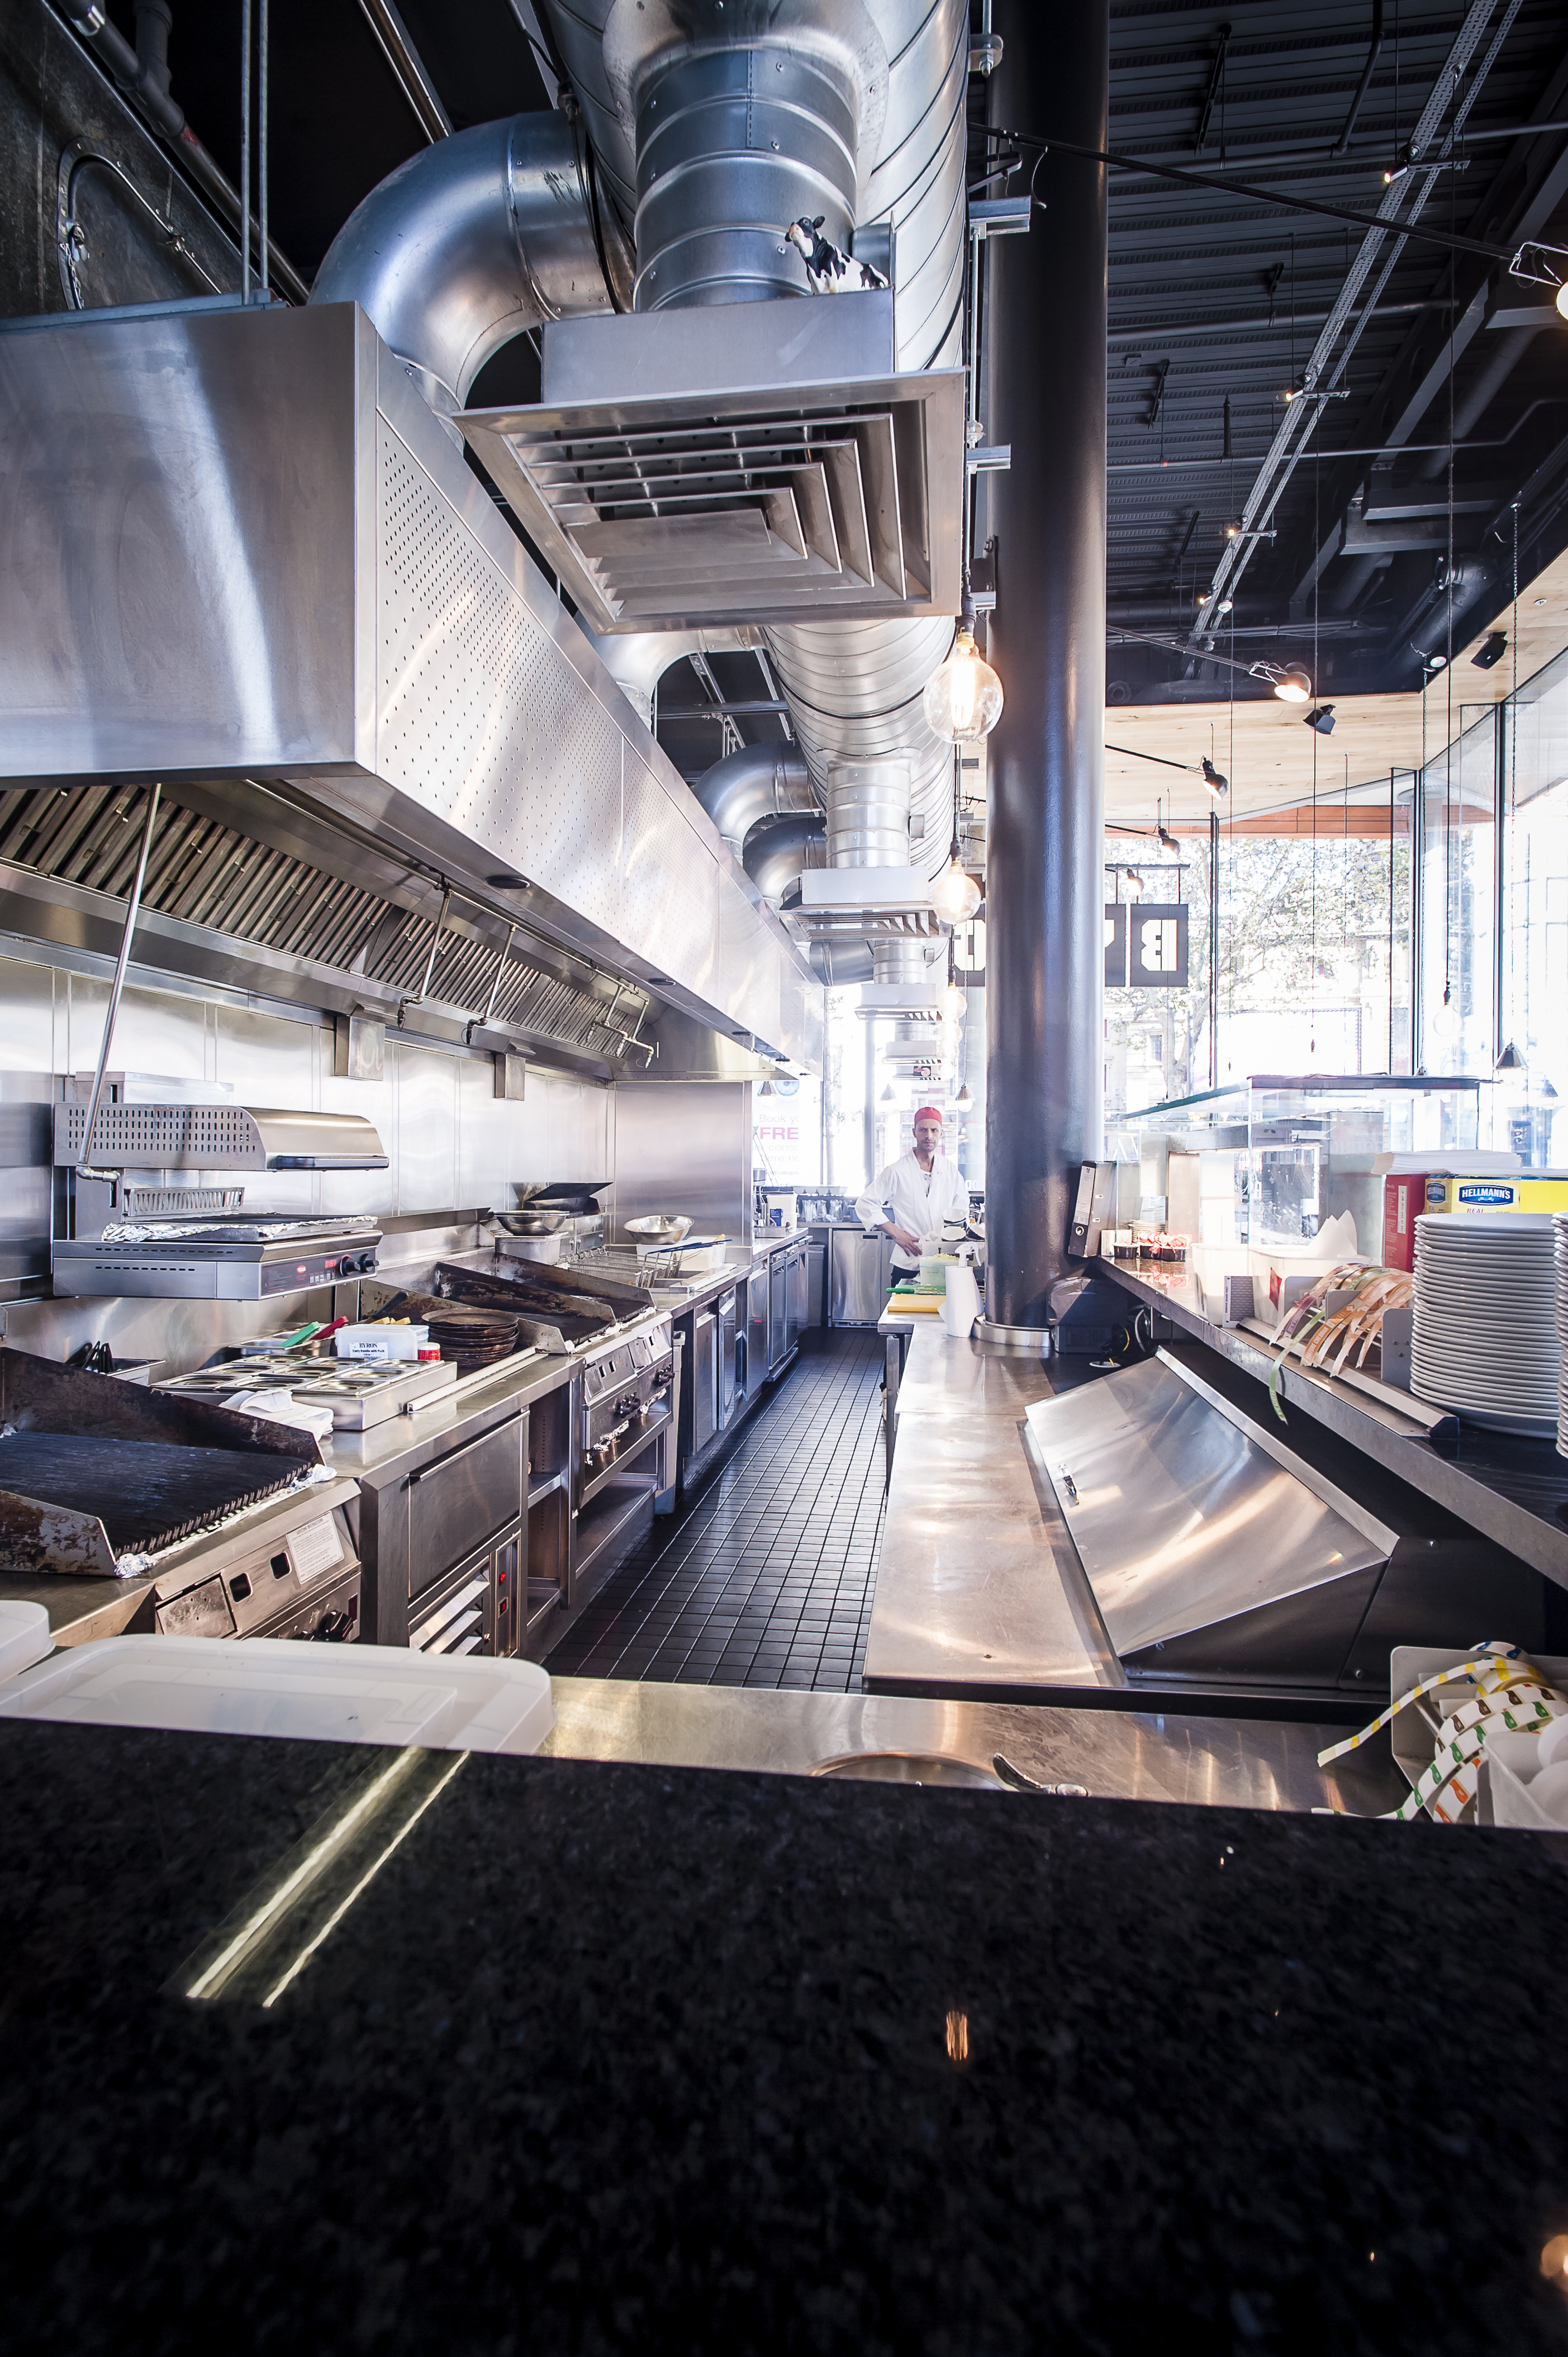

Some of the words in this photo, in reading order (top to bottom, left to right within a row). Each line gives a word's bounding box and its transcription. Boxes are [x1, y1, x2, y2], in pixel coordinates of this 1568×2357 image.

[759, 1114, 786, 1123] Book
[1462, 1187, 1511, 1200] HELLMANN'S
[1313, 1326, 1329, 1344] CHEDDAR
